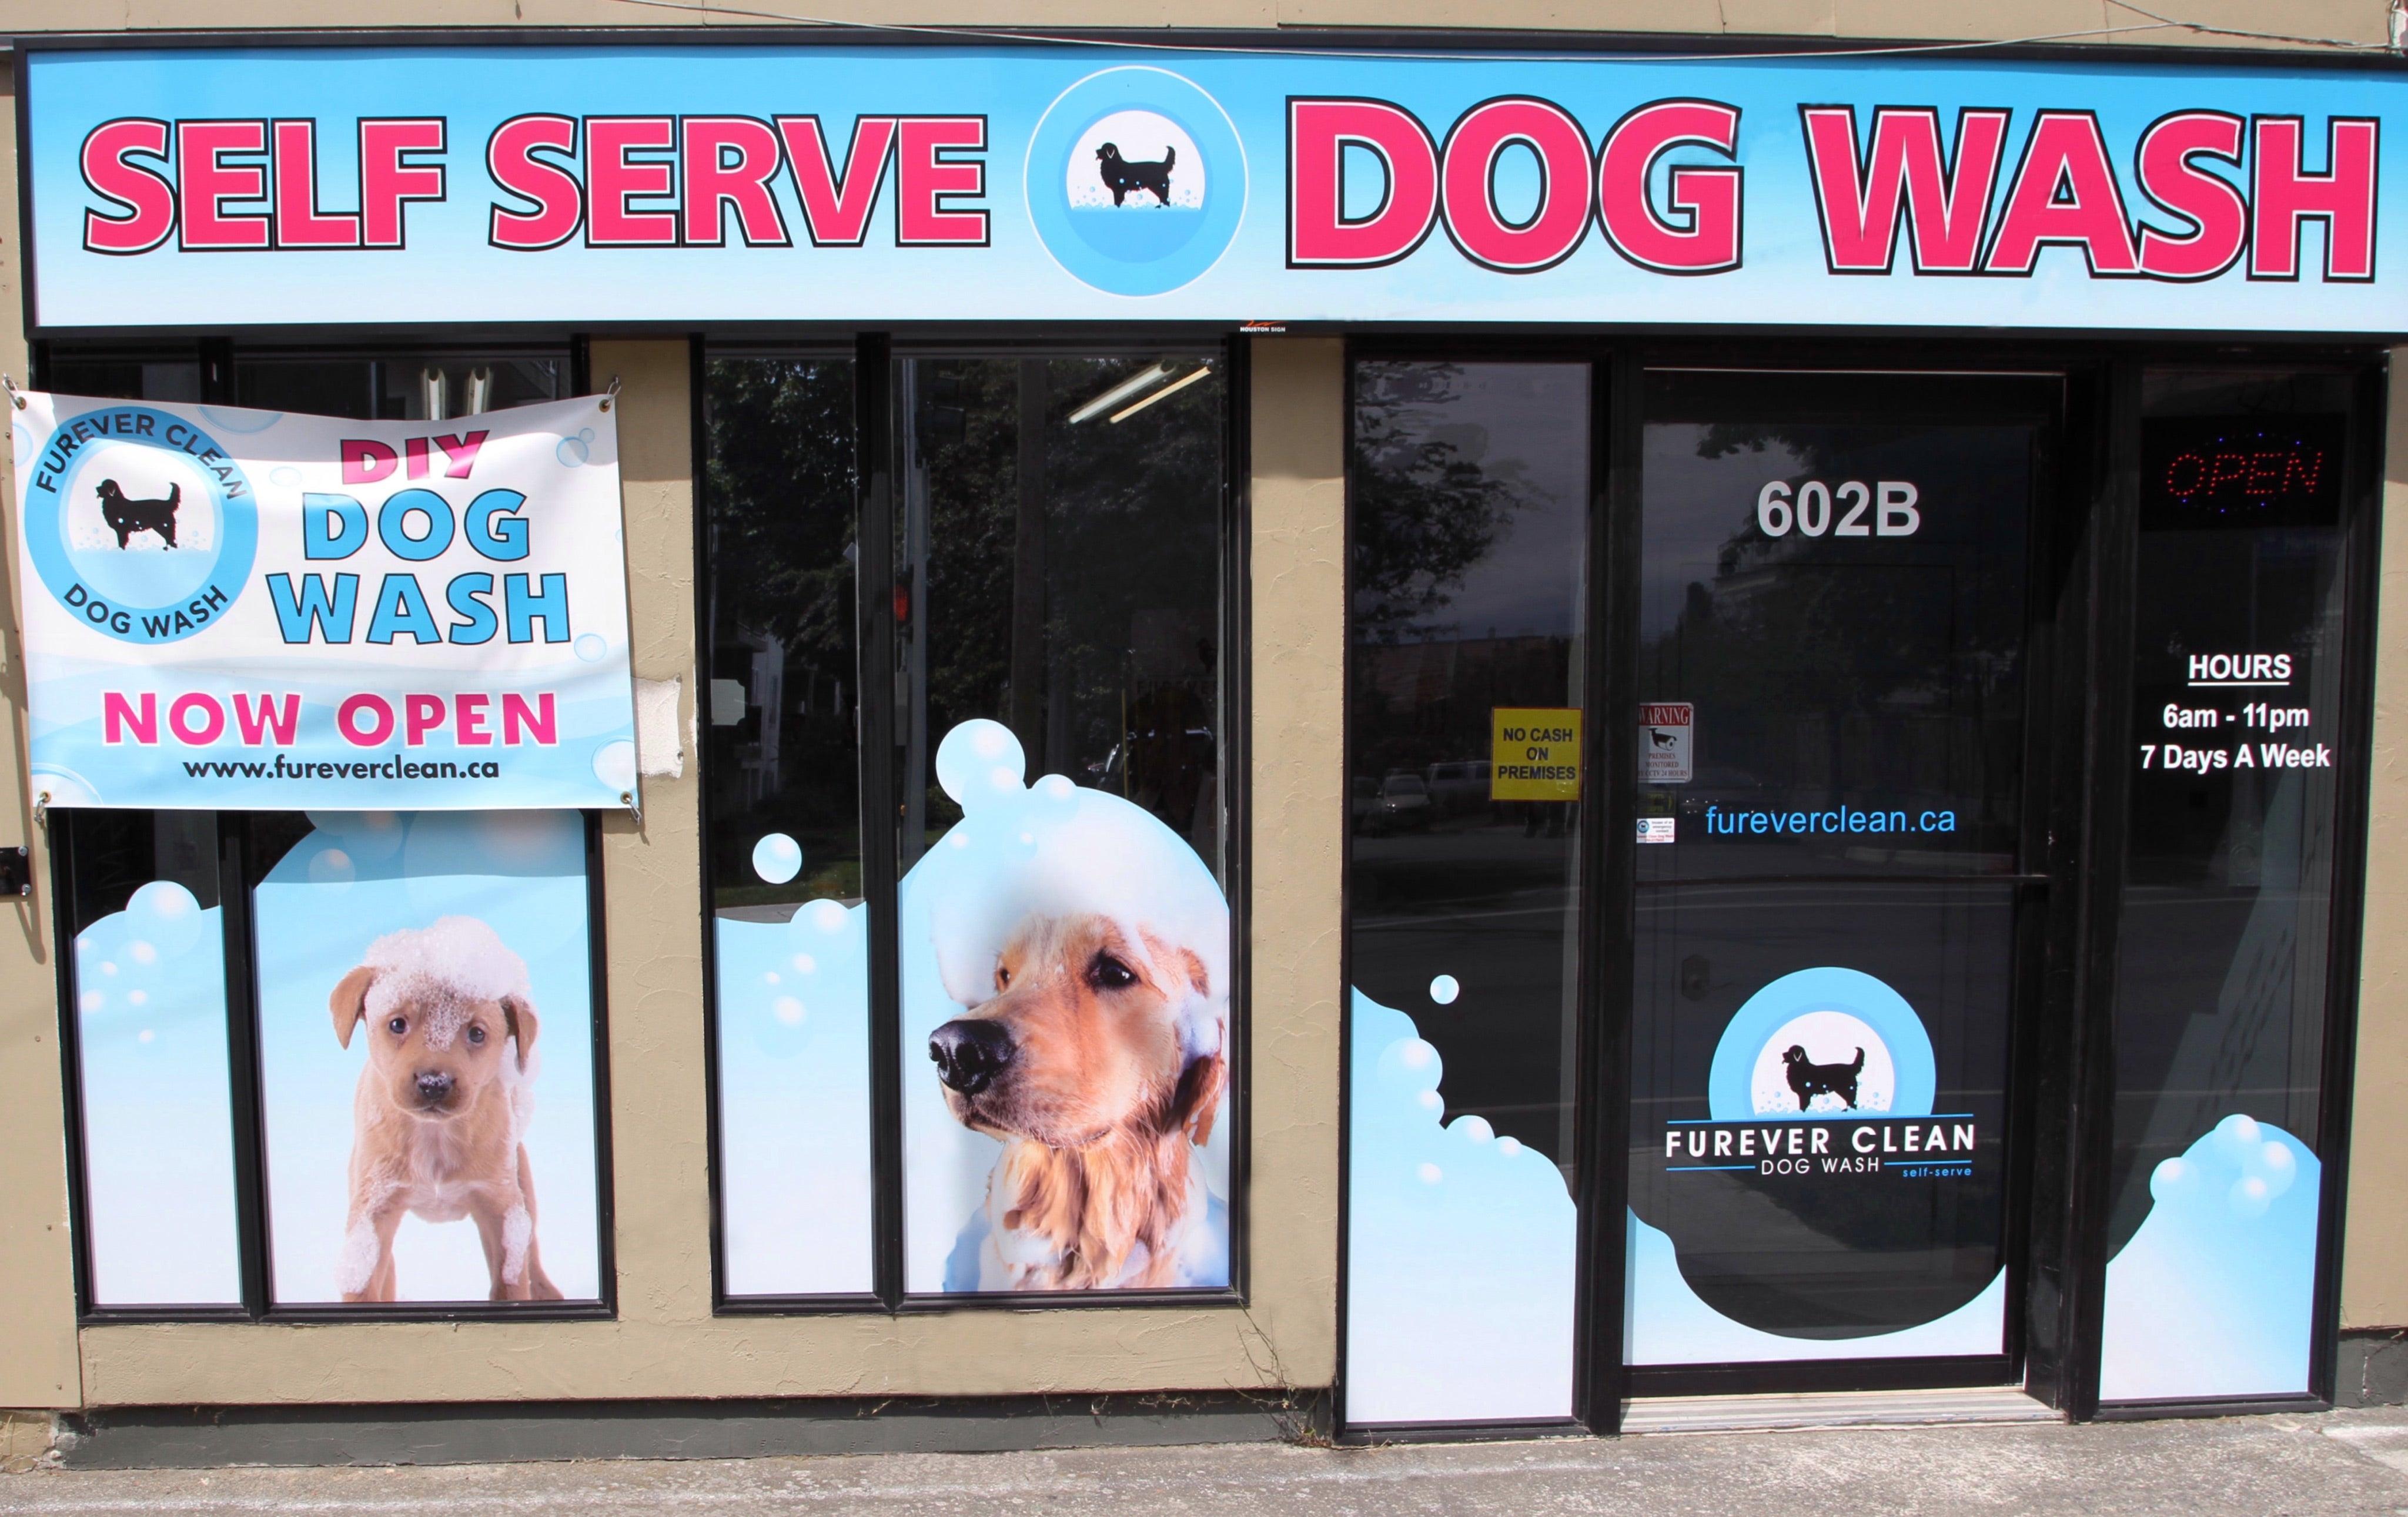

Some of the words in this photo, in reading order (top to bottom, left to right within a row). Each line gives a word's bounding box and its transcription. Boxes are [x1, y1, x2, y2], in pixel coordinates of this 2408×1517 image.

[79, 116, 447, 255] SELF
[484, 112, 991, 254] SERVE
[1286, 93, 1744, 276] DOG
[1798, 101, 2381, 286] WASH
[36, 413, 155, 493] FUREVER
[165, 424, 247, 500] CLEAN
[340, 430, 489, 484] DIY
[2167, 452, 2322, 496] OPEN
[1758, 481, 1920, 537] 602B
[302, 488, 530, 561] DOG
[63, 583, 131, 635] DOG
[141, 585, 229, 638] WASH
[266, 571, 571, 646] WASH
[2188, 654, 2292, 679] HOURS
[103, 692, 302, 745] NOW
[337, 692, 559, 746] OPEN
[1638, 706, 1688, 724] WARNING
[2163, 704, 2217, 728] 6am
[2243, 703, 2309, 732] 11pm
[1503, 728, 1526, 742] NO
[1530, 728, 1573, 742] CASH
[183, 754, 500, 779] www.fureverclean.ca
[1526, 746, 1549, 761] ON
[2140, 745, 2156, 769] 7
[2164, 744, 2228, 774] Days
[2234, 745, 2254, 767] A
[2260, 744, 2330, 767] Week
[1498, 766, 1576, 780] PREMISES
[1706, 806, 1955, 834] fureverclean.ca
[1666, 1128, 1829, 1157] FUREVER
[1852, 1124, 1974, 1153] CLEAN
[1761, 1159, 1810, 1175] DOG
[1822, 1157, 1879, 1173] WASH
[1903, 1167, 1972, 1177] self-serve
